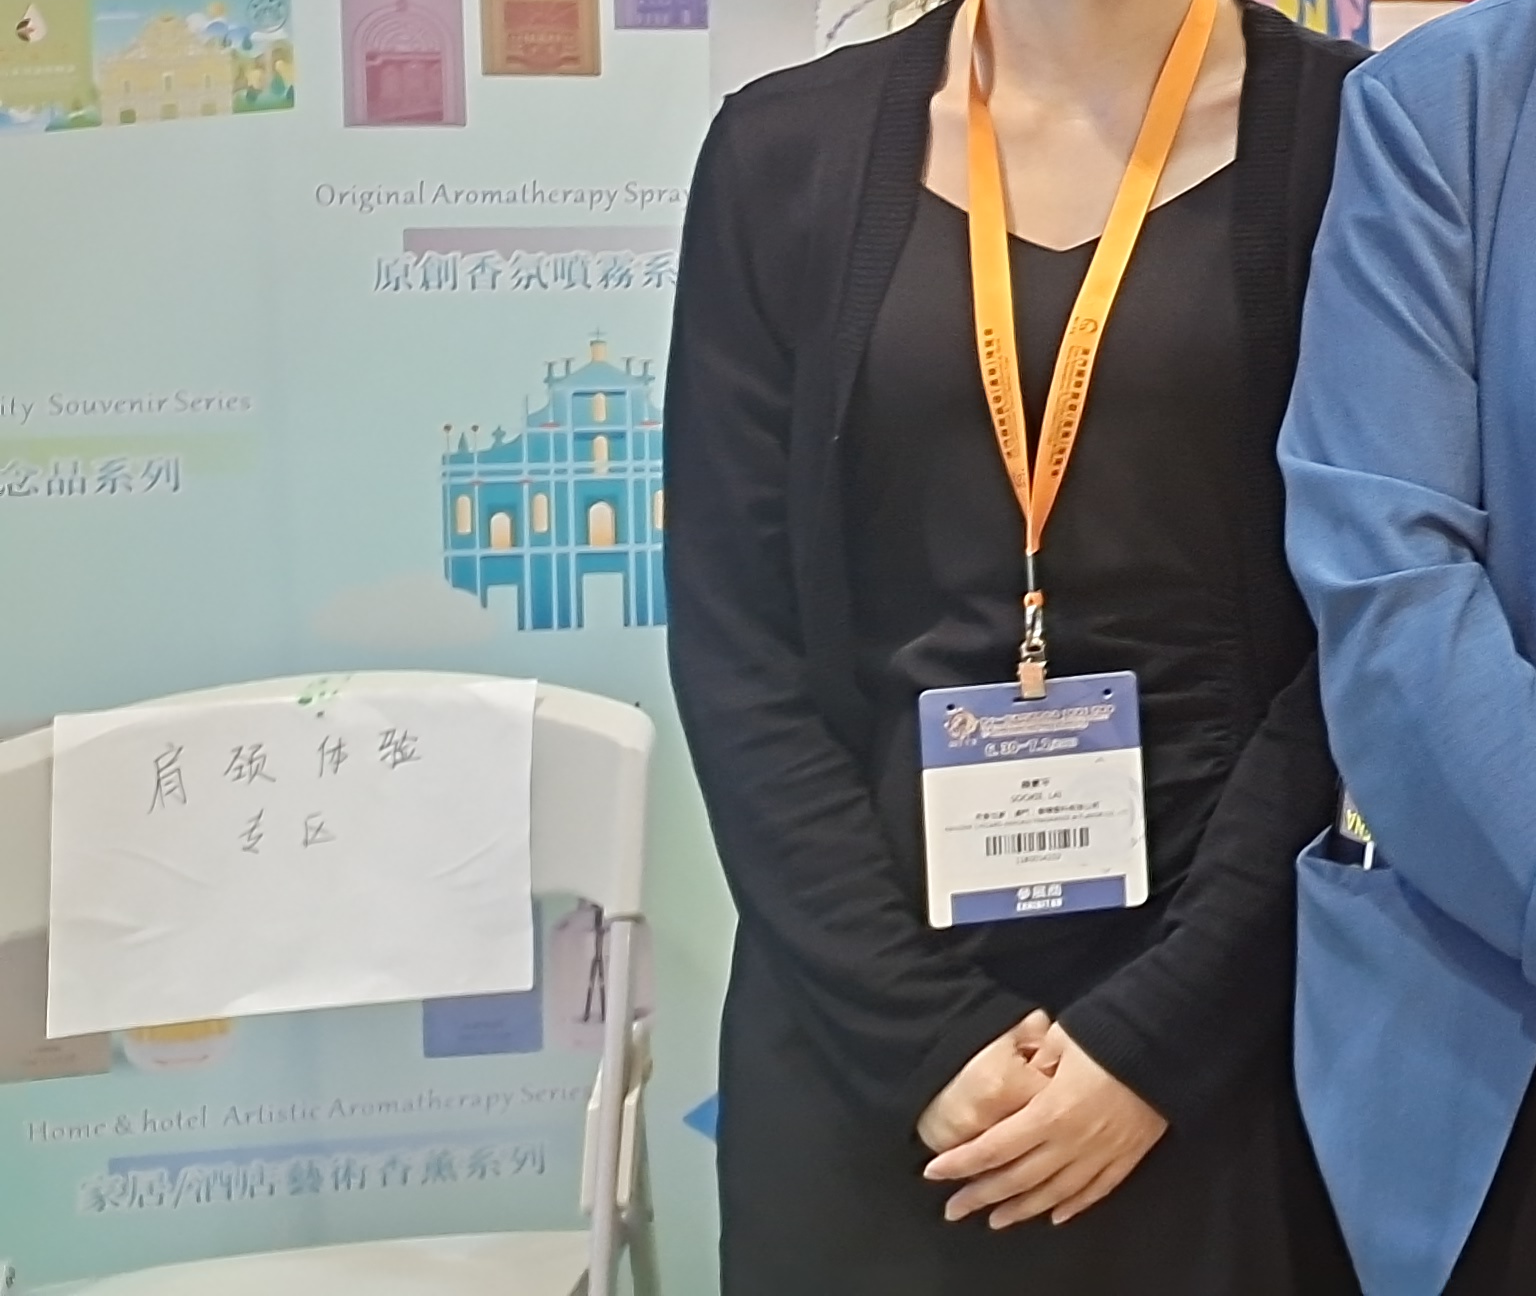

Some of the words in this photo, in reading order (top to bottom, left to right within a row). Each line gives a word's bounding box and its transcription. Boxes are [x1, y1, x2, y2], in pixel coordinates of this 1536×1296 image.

[315, 179, 425, 213] Original
[432, 180, 618, 212] Aromatherapy
[48, 392, 169, 417] Souvenir
[174, 389, 253, 413] Series
[114, 1114, 135, 1135] &
[141, 1104, 209, 1132] hotel
[223, 1100, 319, 1128] Artistic
[326, 1088, 514, 1120] Aromatherapy
